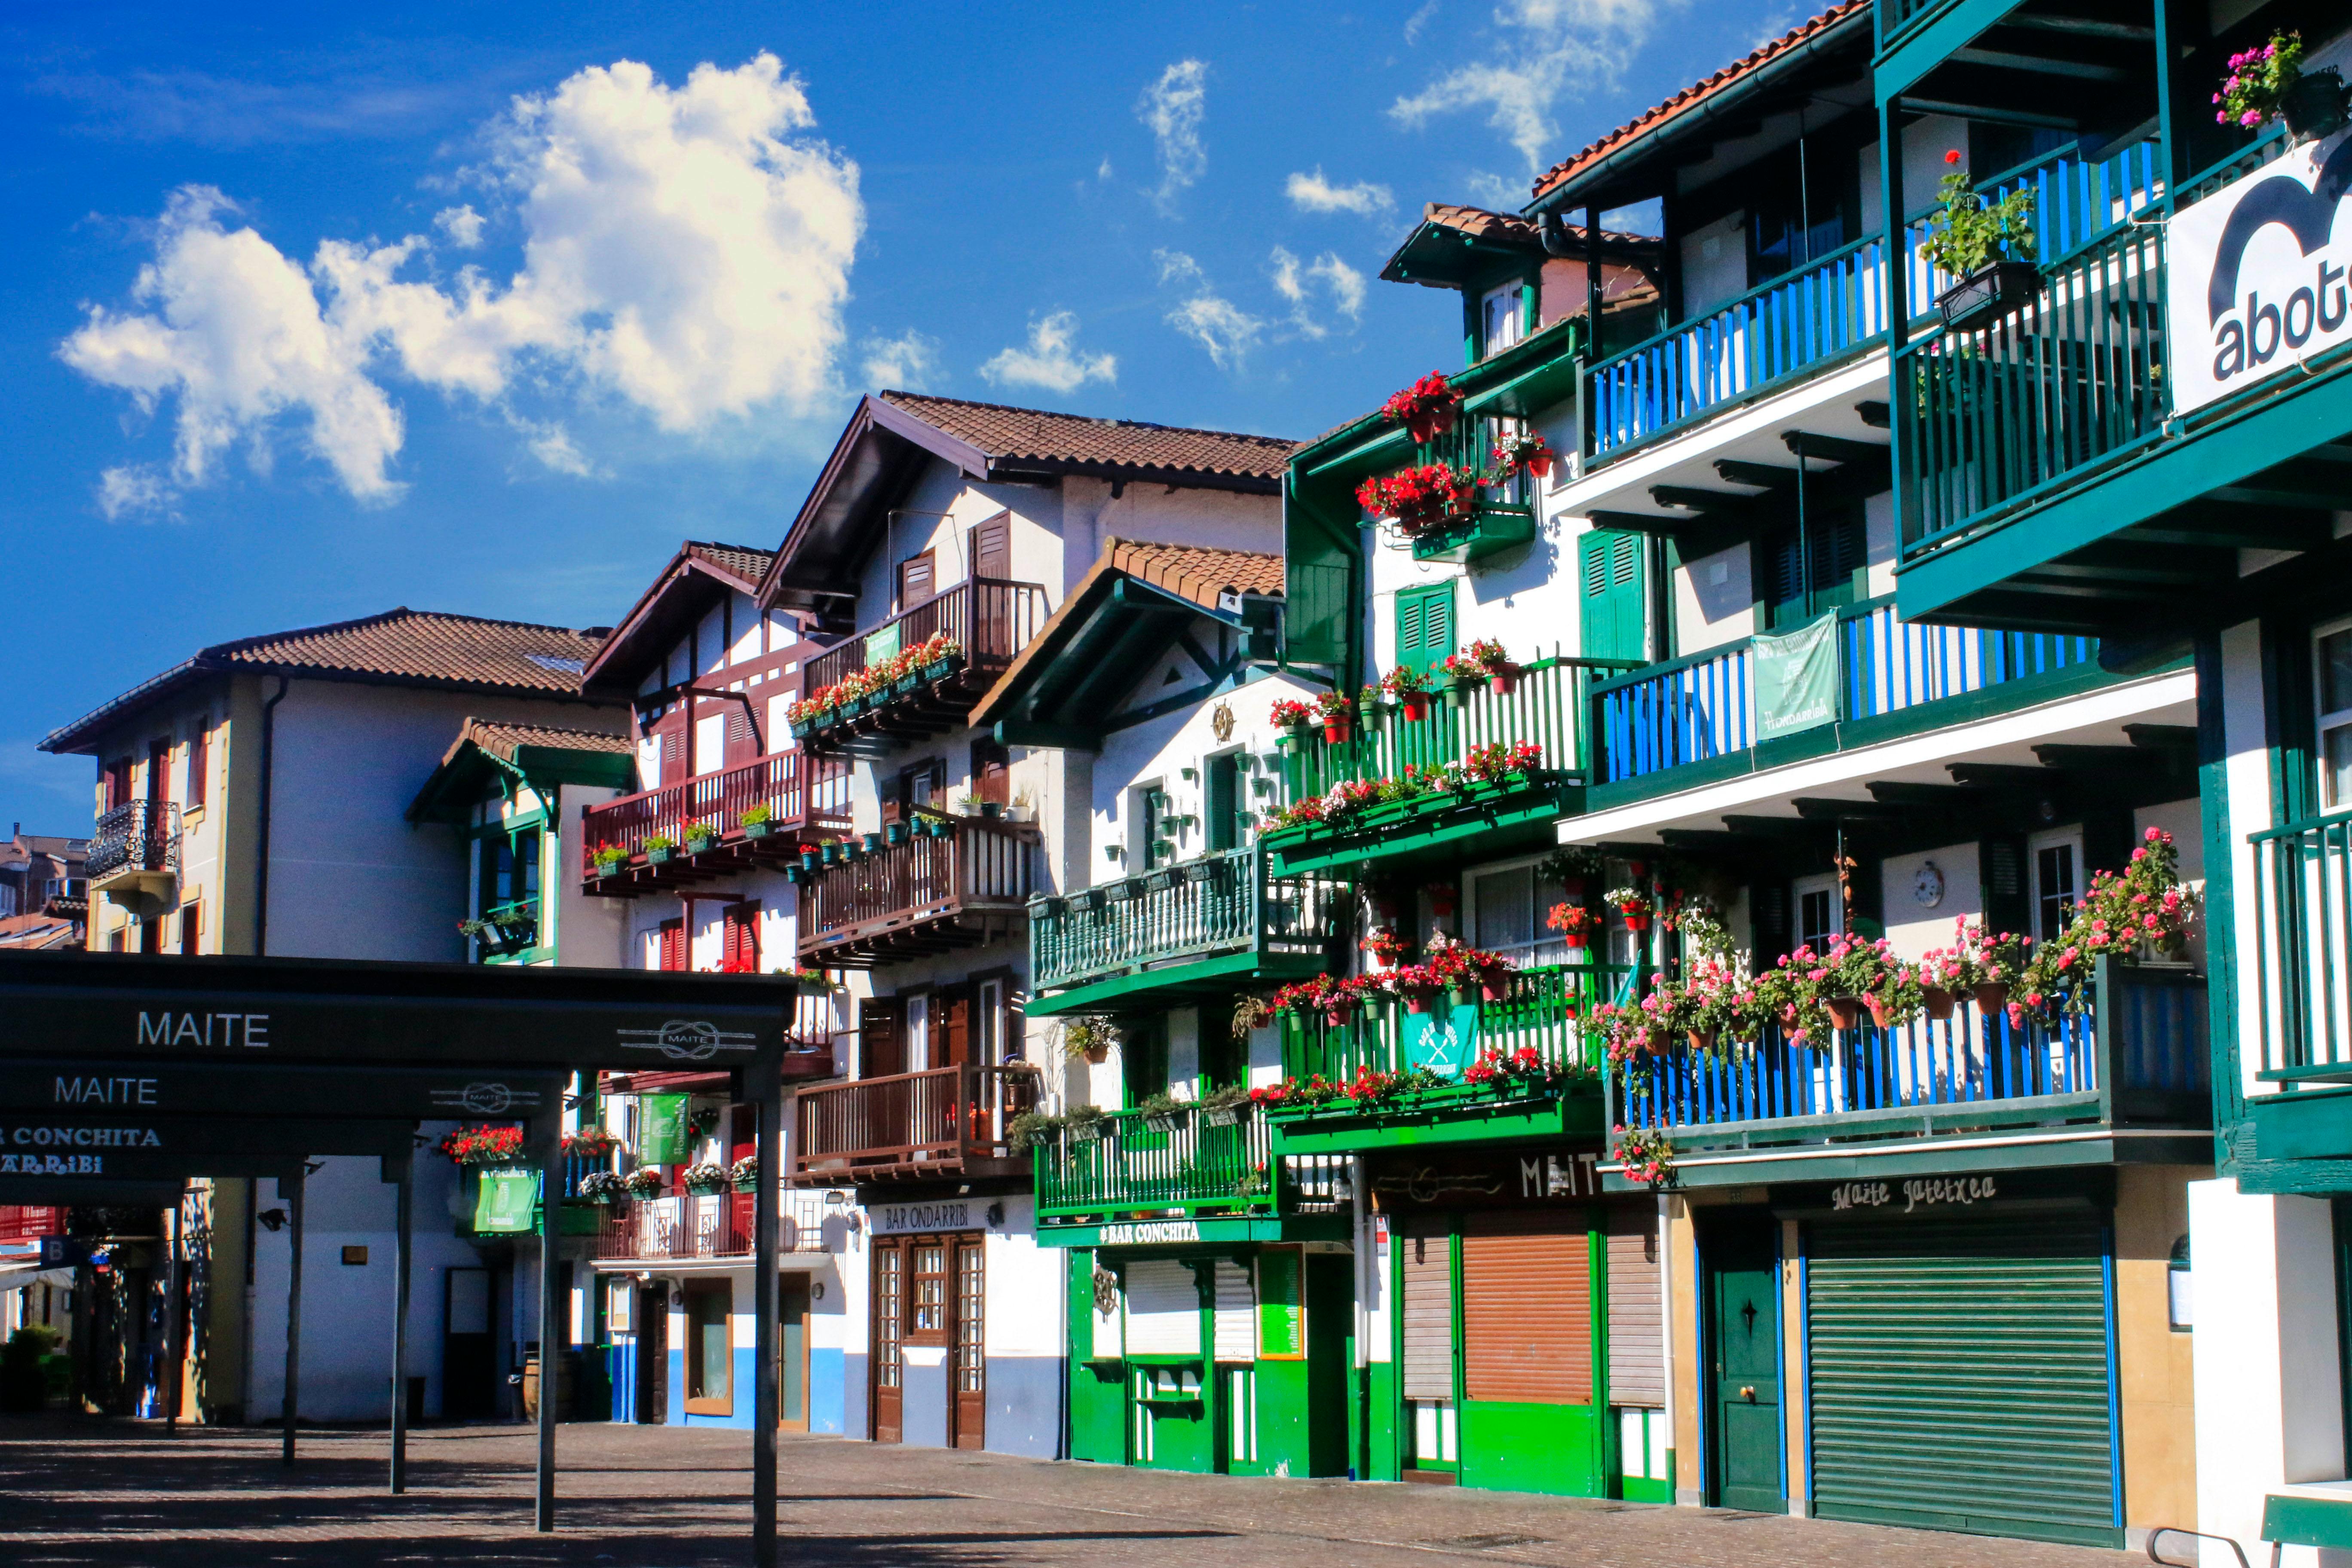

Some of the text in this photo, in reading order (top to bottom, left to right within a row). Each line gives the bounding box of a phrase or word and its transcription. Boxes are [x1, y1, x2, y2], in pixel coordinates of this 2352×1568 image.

[2213, 259, 2352, 382] abot
[137, 1011, 269, 1047] MAITE
[668, 1035, 708, 1044] MAITE
[55, 1077, 158, 1105] MAITE
[13, 1127, 161, 1146] CONCHITA
[1832, 1182, 1890, 1211] Maite
[885, 1204, 969, 1230] BAR ONDARRIBI
[1108, 1221, 1200, 1244] BAR CONCHITA
